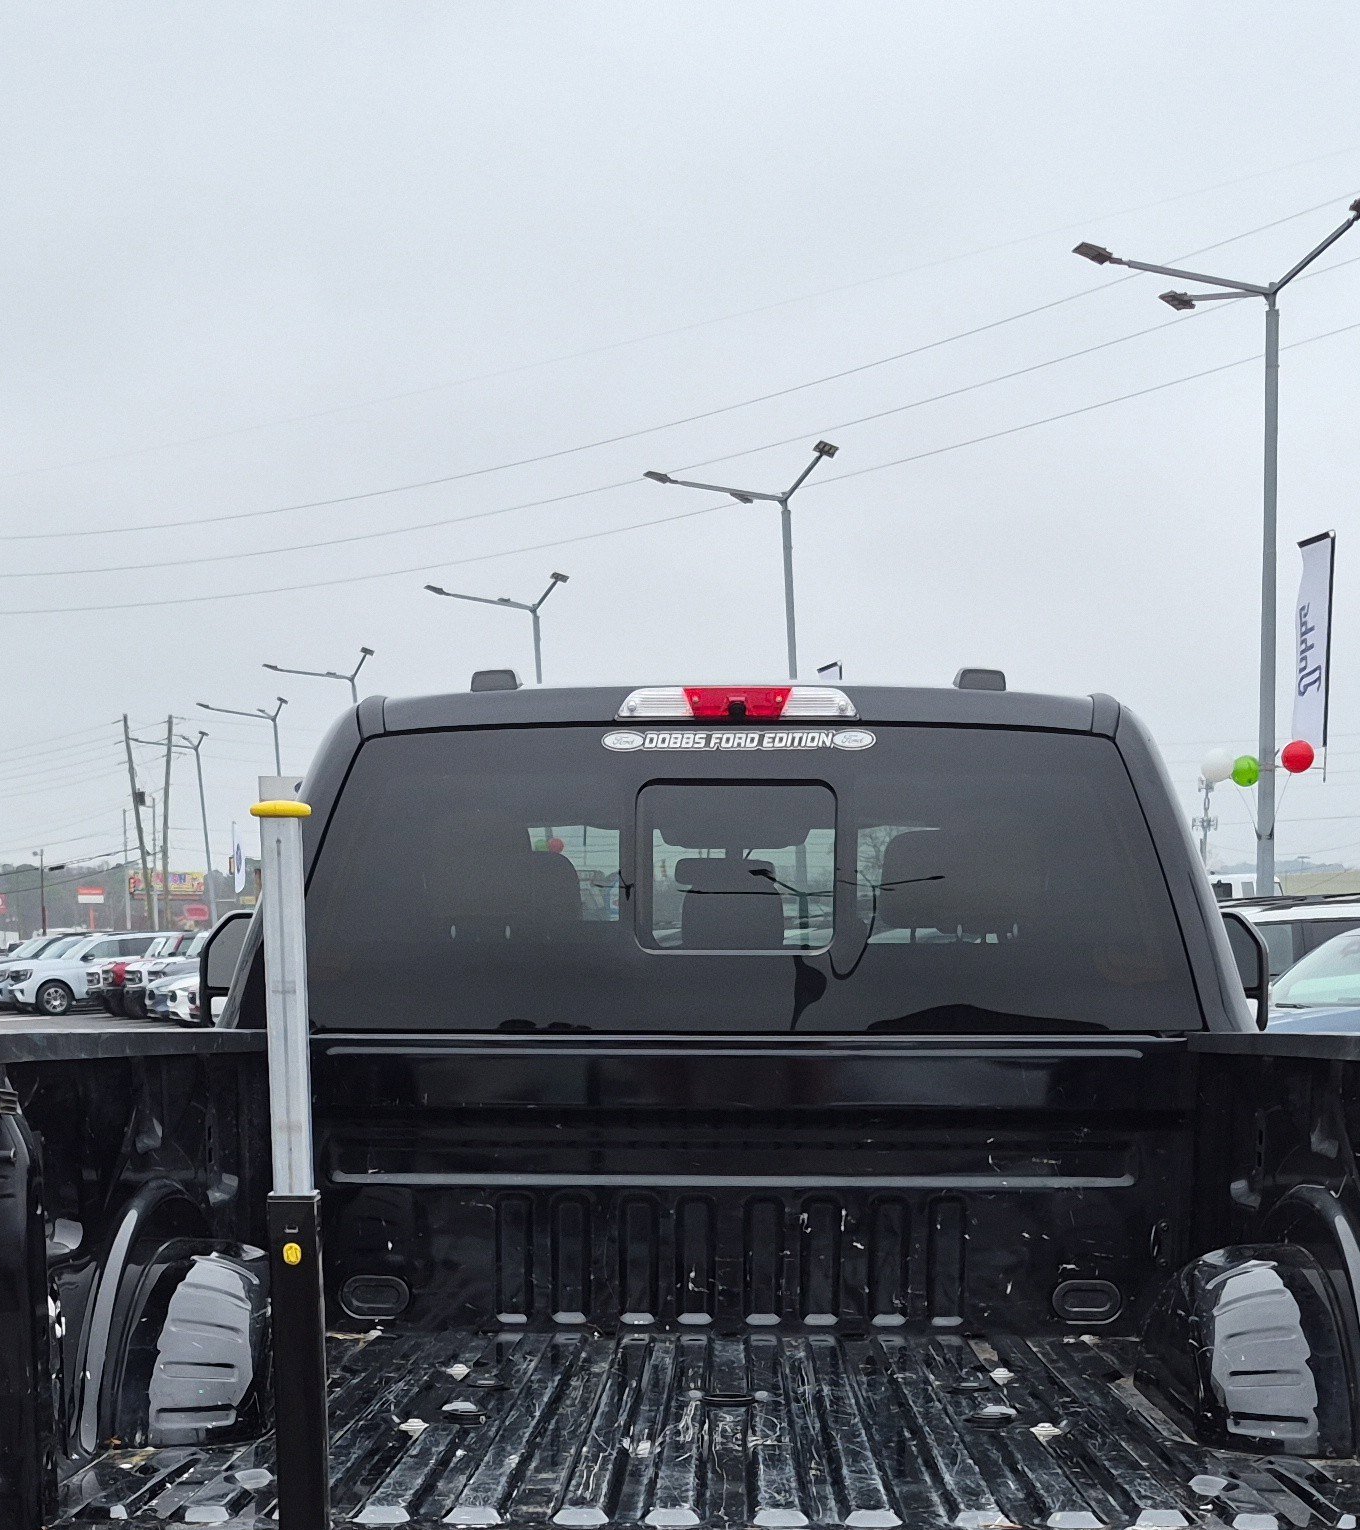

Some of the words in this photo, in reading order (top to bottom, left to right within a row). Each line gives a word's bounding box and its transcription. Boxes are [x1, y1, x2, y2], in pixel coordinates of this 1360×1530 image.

[644, 733, 707, 748] DOBBS
[709, 733, 760, 748] FORD
[762, 732, 834, 748] EDITION
